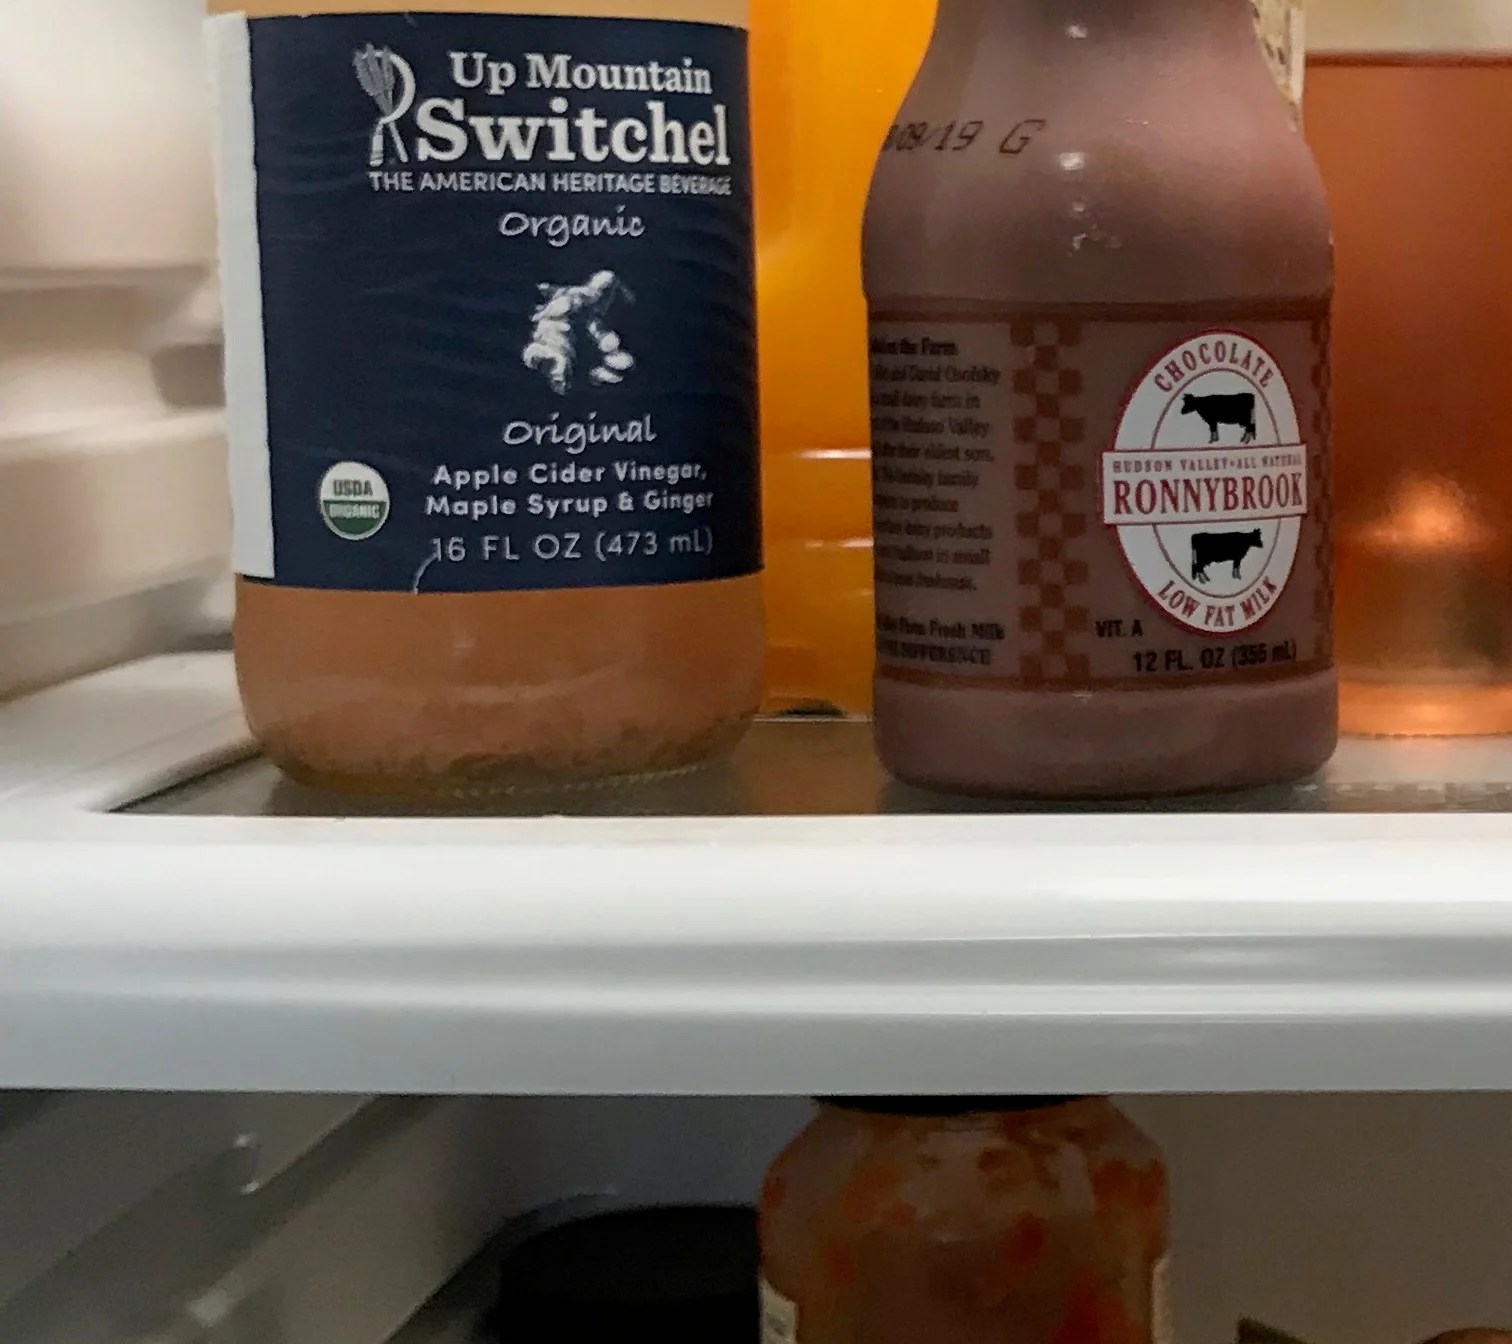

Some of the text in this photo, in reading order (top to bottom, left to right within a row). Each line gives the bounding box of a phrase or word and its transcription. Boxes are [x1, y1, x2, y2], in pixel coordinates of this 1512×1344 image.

[450, 51, 714, 95] Up Mountain
[415, 96, 732, 166] Switchel
[999, 118, 1047, 154] G
[369, 170, 733, 196] THE AMERICAN HERITAGE BEVERAGE
[498, 204, 647, 248] Organic
[1153, 339, 1274, 393] CHOCOLATE
[502, 410, 658, 455] Original
[432, 459, 708, 491] Apple Cider Vinegar,
[1112, 459, 1173, 474] HUDSON
[332, 479, 374, 498] USDA
[424, 489, 714, 521] Maple Syrup & Ginger
[1112, 471, 1304, 516] RONNYBROOK
[328, 503, 381, 520] ORGANIC
[432, 526, 714, 563] 16 FL OZ (473 mL)
[1157, 575, 1278, 628] LOW FAT MILK
[1131, 619, 1143, 638] A
[1133, 649, 1159, 672] 12
[1200, 647, 1226, 669] OZ
[1231, 641, 1268, 668] (355
